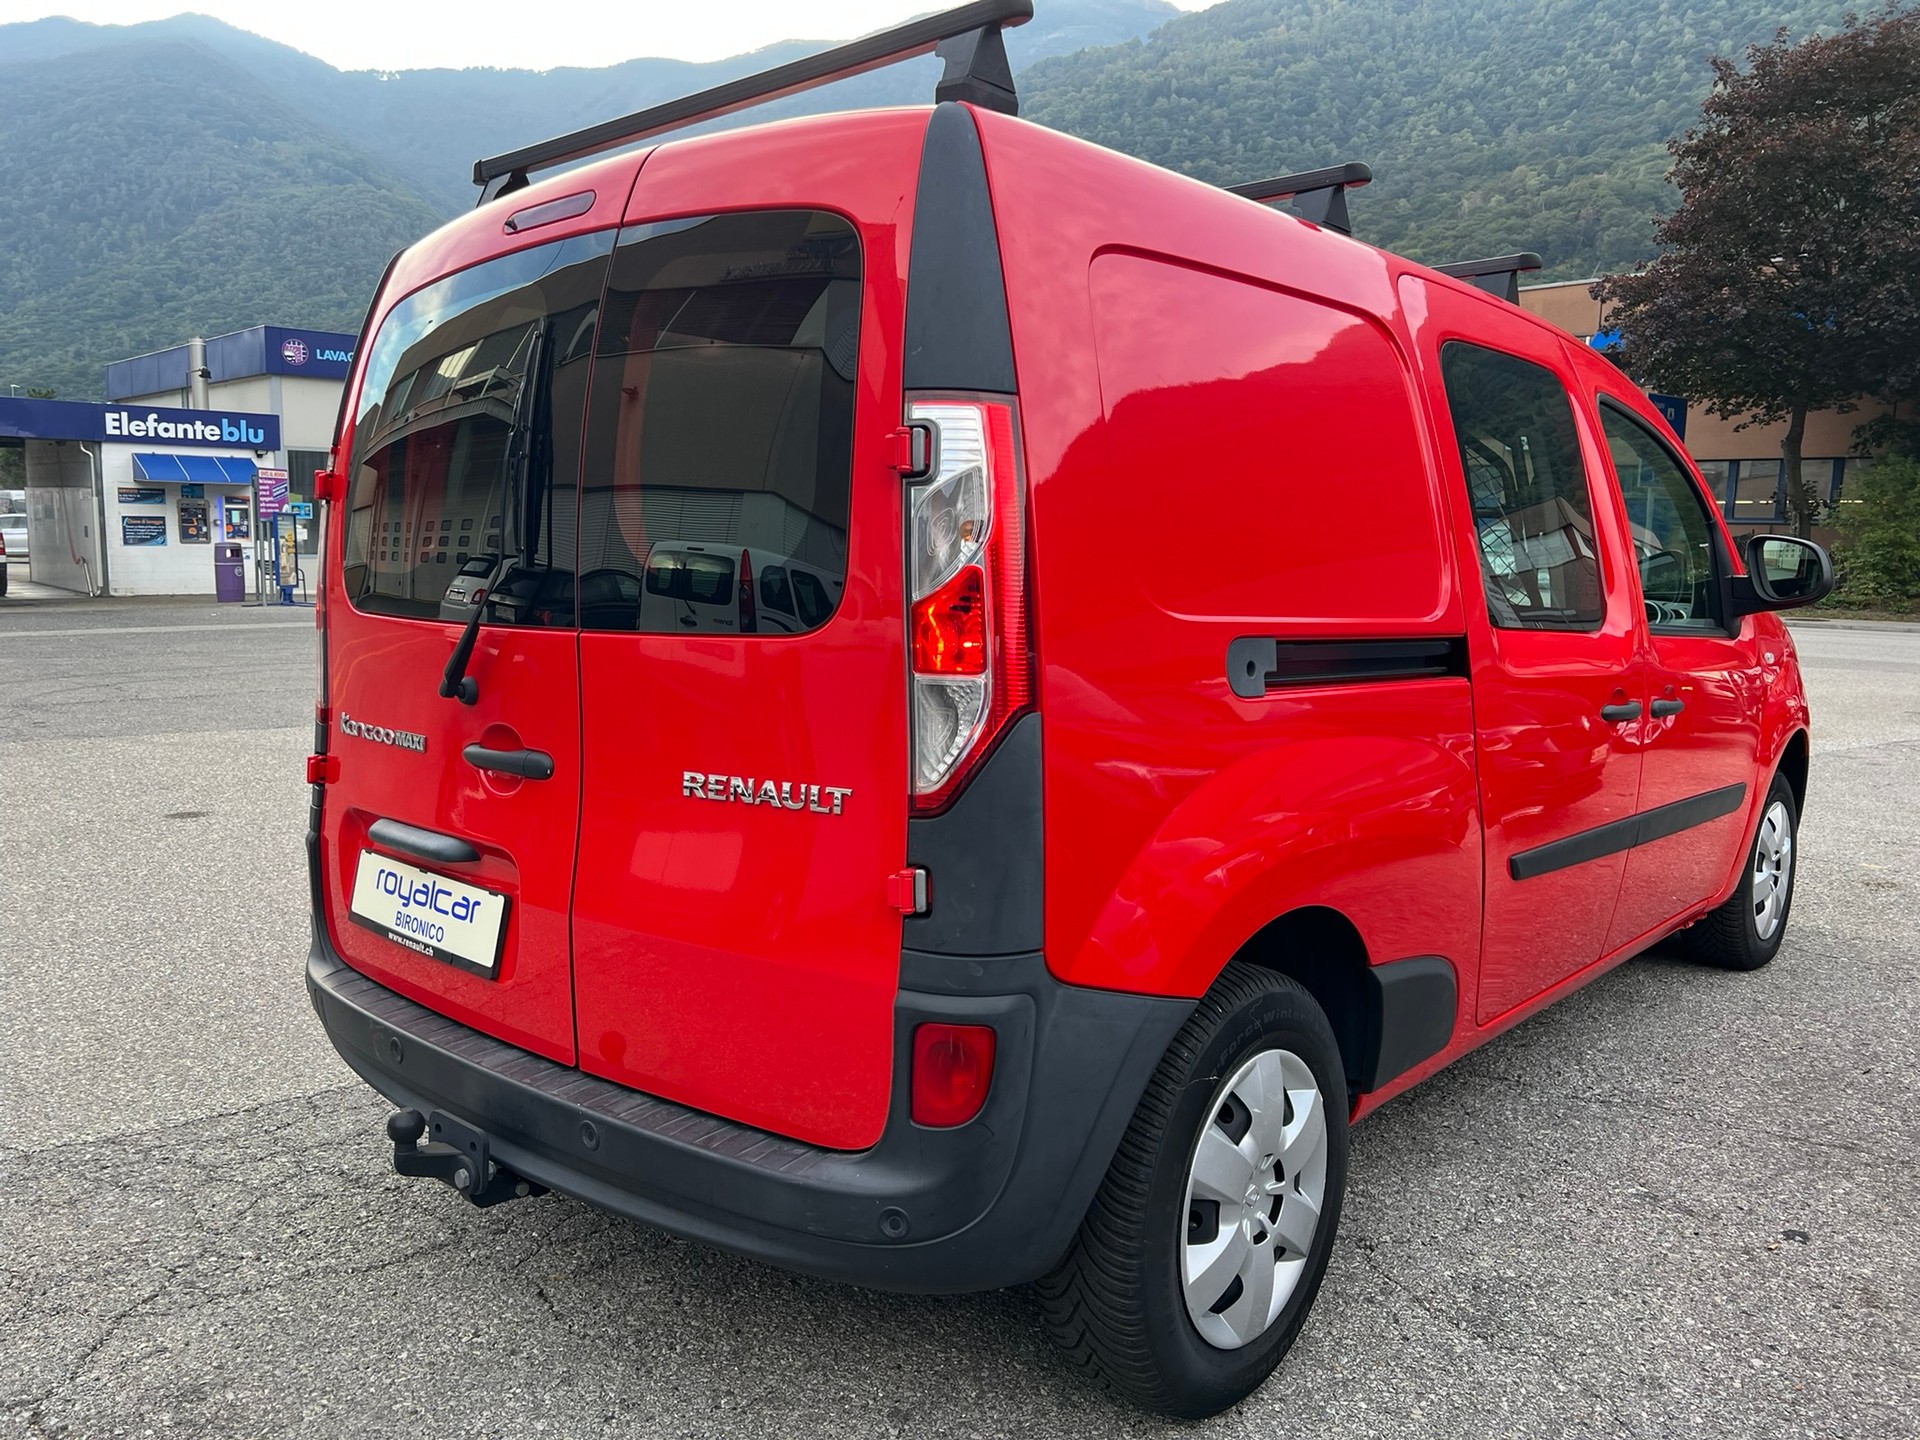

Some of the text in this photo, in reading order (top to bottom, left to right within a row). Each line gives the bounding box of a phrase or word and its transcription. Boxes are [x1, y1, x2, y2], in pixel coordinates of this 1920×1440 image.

[395, 730, 426, 753] MAXI
[682, 771, 852, 815] RENAULT
[395, 910, 444, 943] BIRONICO
[388, 931, 434, 957] www.renault.ch
